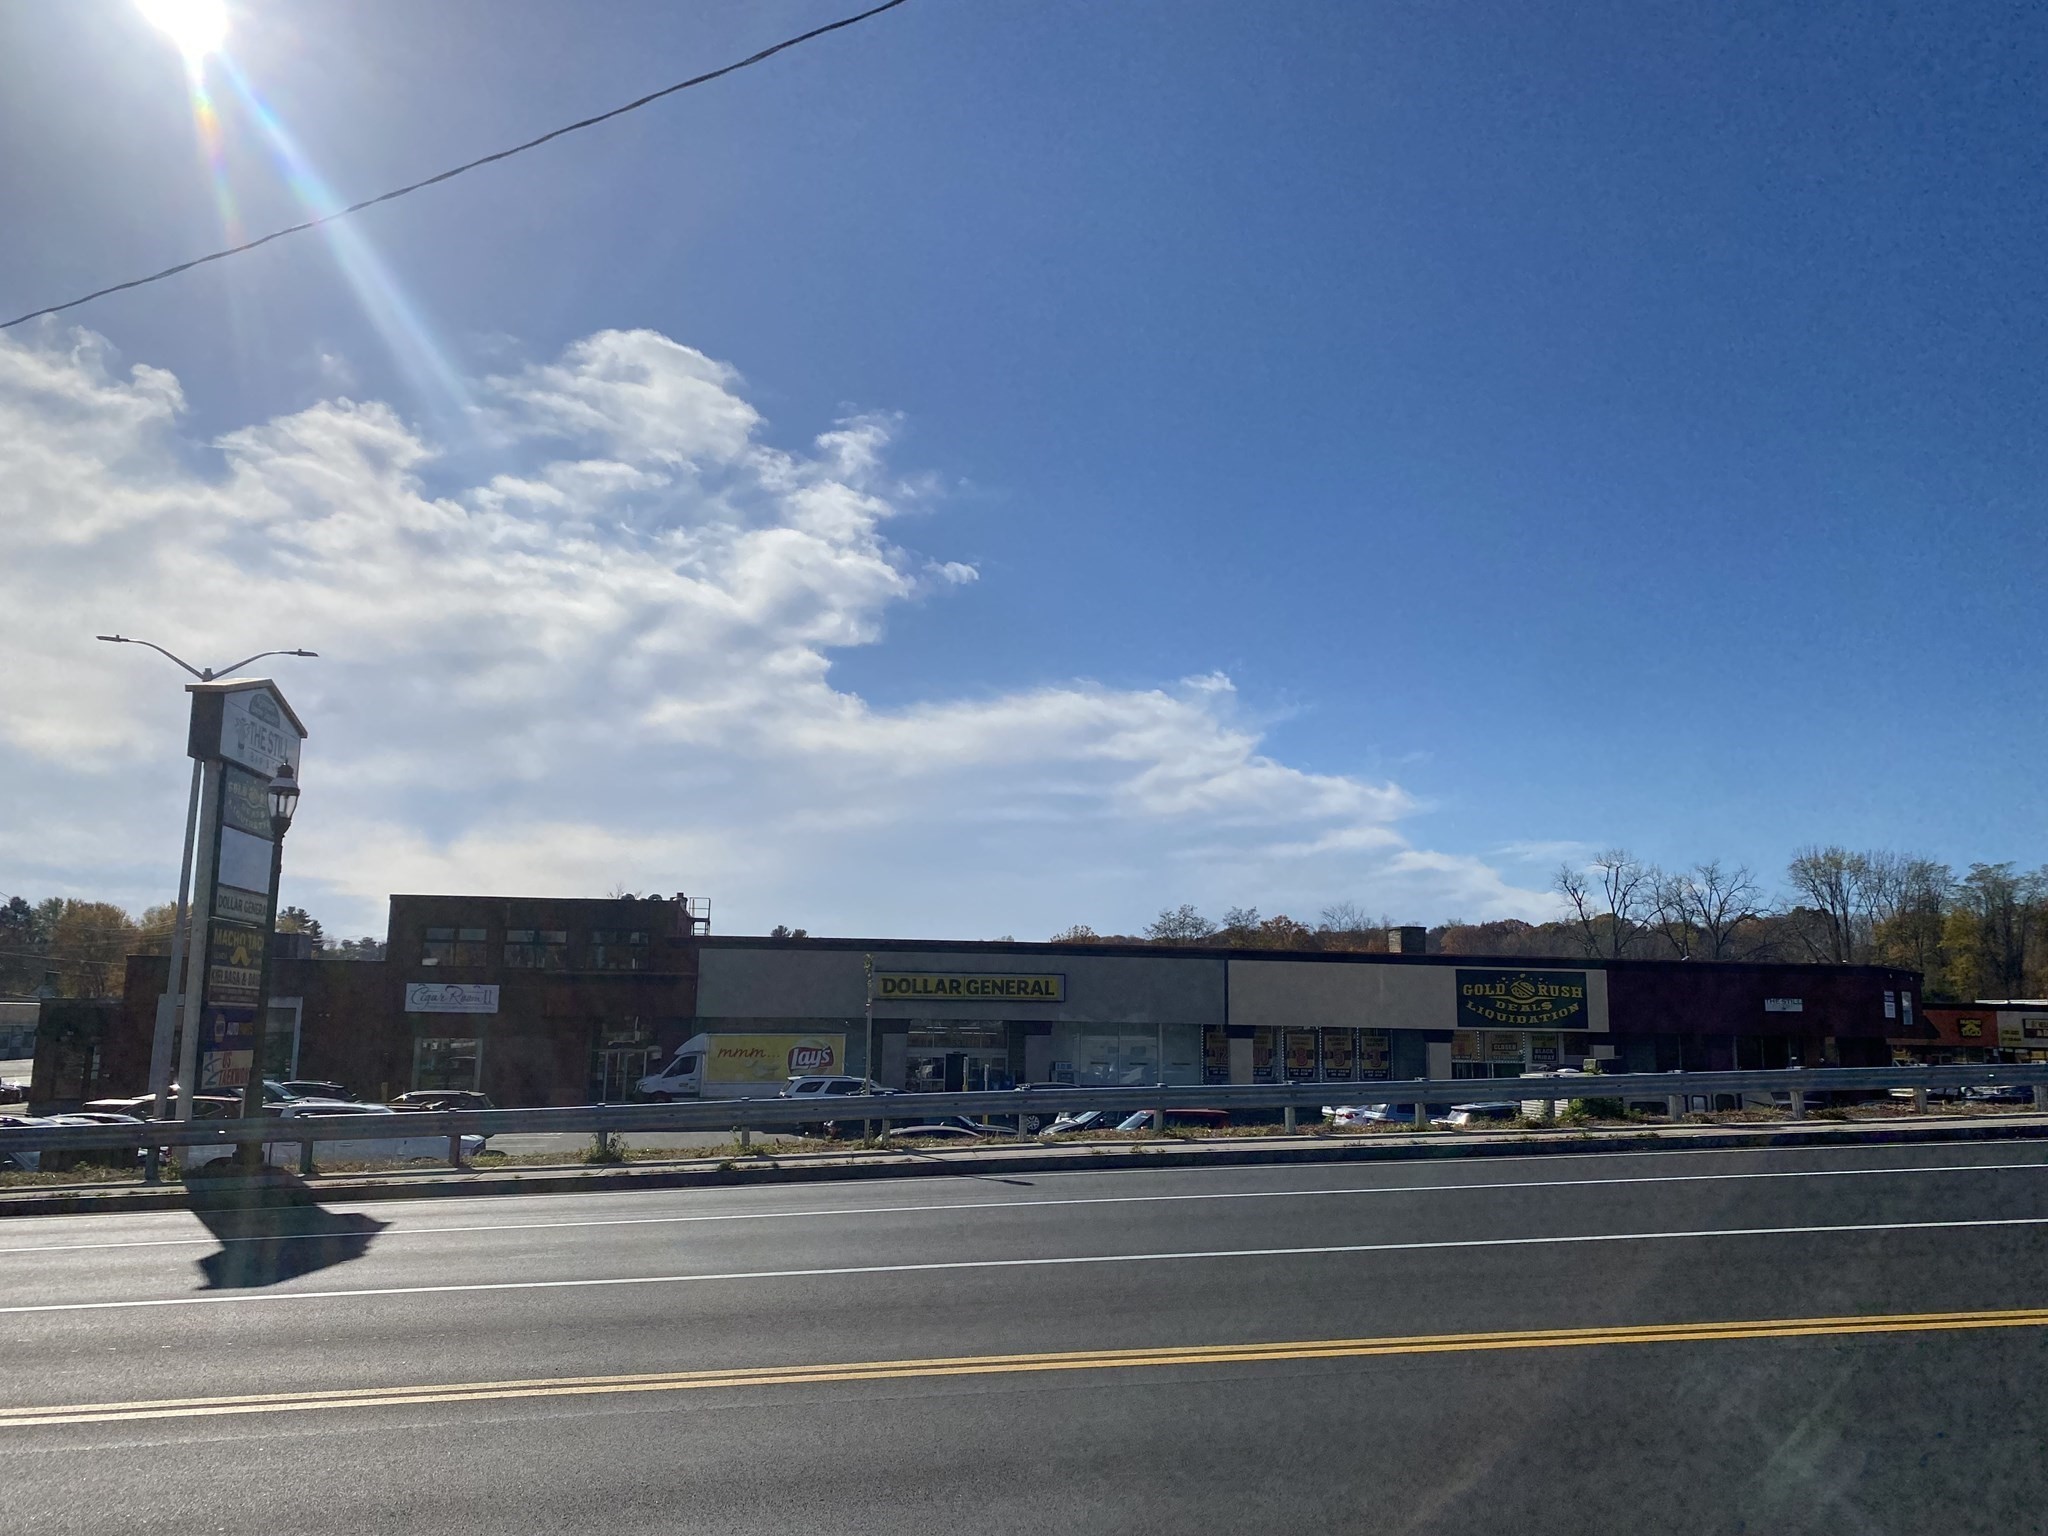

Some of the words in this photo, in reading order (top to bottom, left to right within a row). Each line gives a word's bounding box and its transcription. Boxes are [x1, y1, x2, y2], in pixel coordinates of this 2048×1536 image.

[249, 720, 268, 751] THE
[217, 893, 243, 913] DOLLAR
[243, 900, 267, 916] GENERA
[213, 926, 246, 948] MACHO
[411, 985, 447, 1010] Cigar
[445, 985, 481, 1005] Room
[881, 977, 962, 995] DOLLAR
[965, 978, 1055, 996] GENERAL
[1462, 983, 1506, 996] GOLD
[1537, 983, 1583, 998] RUSH
[1465, 1000, 1581, 1025] LIQUIDATION
[1495, 1000, 1553, 1012] DEALS
[790, 1046, 833, 1071] Lay's
